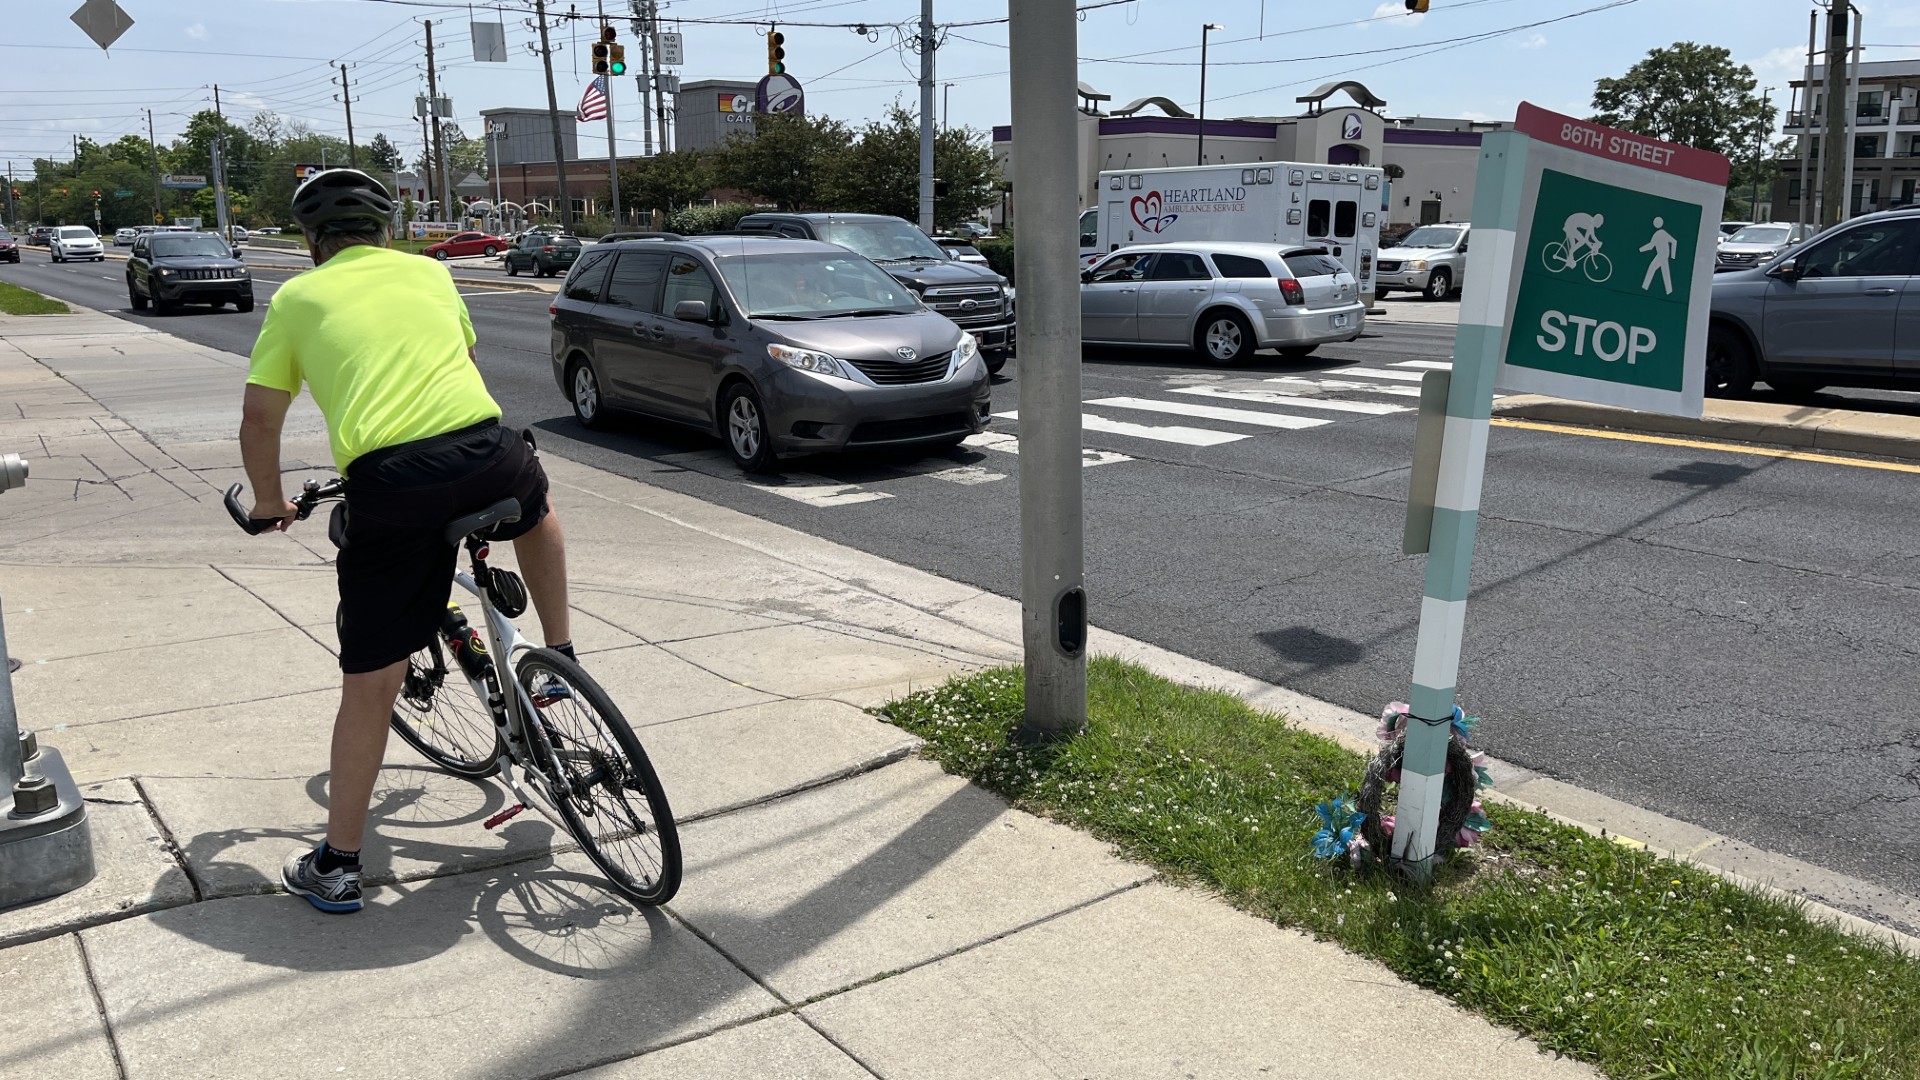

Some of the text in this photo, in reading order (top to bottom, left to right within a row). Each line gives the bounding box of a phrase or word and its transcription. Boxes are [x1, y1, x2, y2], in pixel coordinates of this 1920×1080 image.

[664, 35, 676, 43] NO
[731, 94, 756, 113] Cr
[487, 119, 506, 133] Crew
[726, 114, 752, 123] CAR
[1560, 123, 1676, 167] 86TH STREET
[1163, 186, 1247, 203] HEARTLAND
[1163, 203, 1246, 214] AMBULANCE SERVICE
[1536, 309, 1657, 365] STOP
